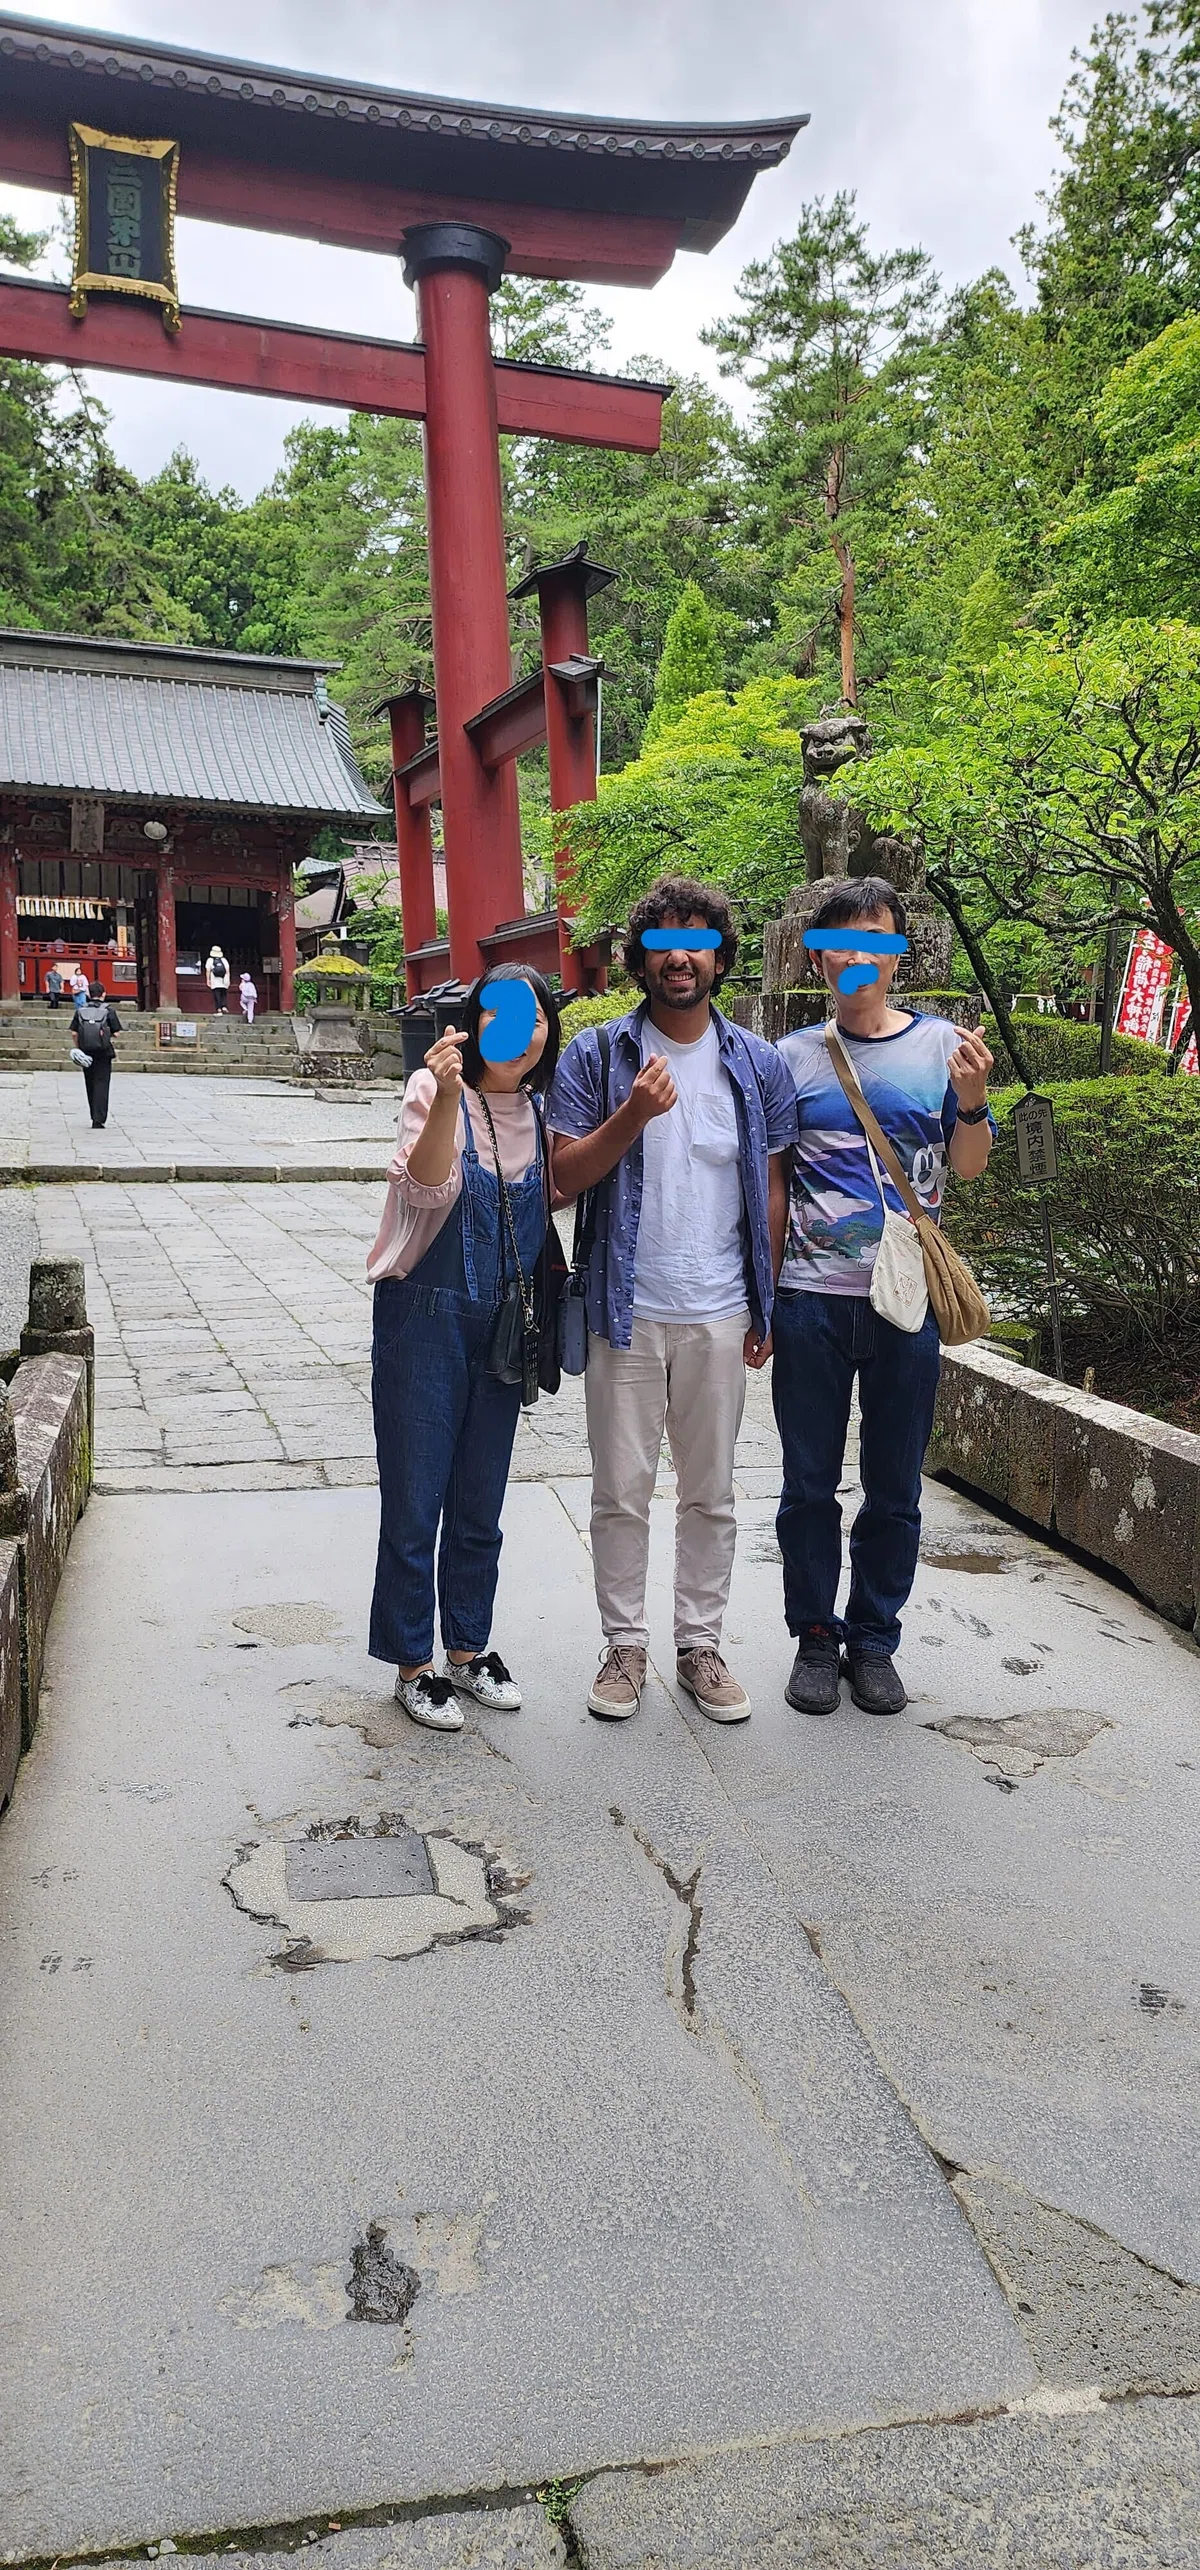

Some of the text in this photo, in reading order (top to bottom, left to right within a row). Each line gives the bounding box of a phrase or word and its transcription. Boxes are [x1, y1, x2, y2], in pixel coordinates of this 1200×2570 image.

[1019, 1109, 1047, 1122] 此の先
[1025, 1121, 1047, 1174] 境内禁煙
